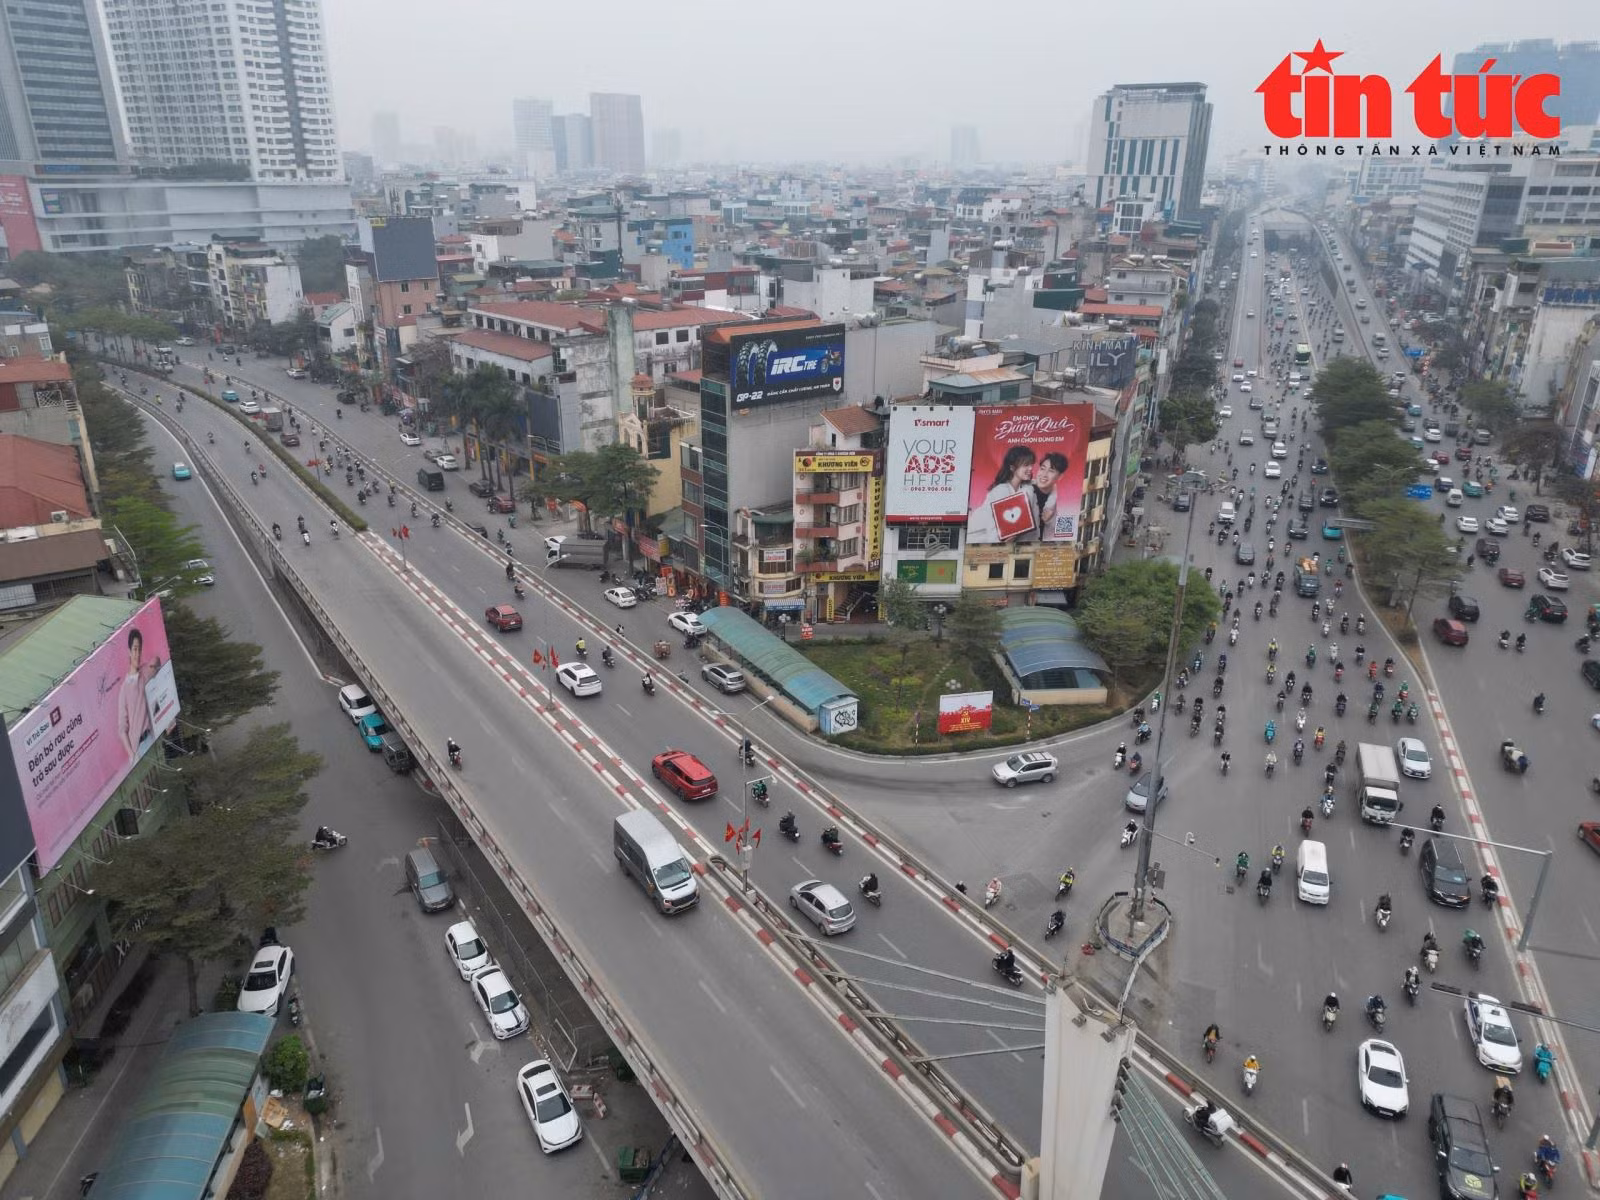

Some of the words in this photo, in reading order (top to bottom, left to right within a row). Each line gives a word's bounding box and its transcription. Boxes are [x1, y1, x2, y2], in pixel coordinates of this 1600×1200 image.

[1075, 353, 1126, 366] LILY
[736, 391, 763, 402] GP-22
[903, 440, 956, 462] YOUR
[904, 455, 956, 473] ADS
[28, 753, 44, 772] Đến
[55, 730, 66, 747] rau
[66, 713, 83, 734] cũng
[44, 757, 58, 775] sau
[57, 739, 75, 761] được
